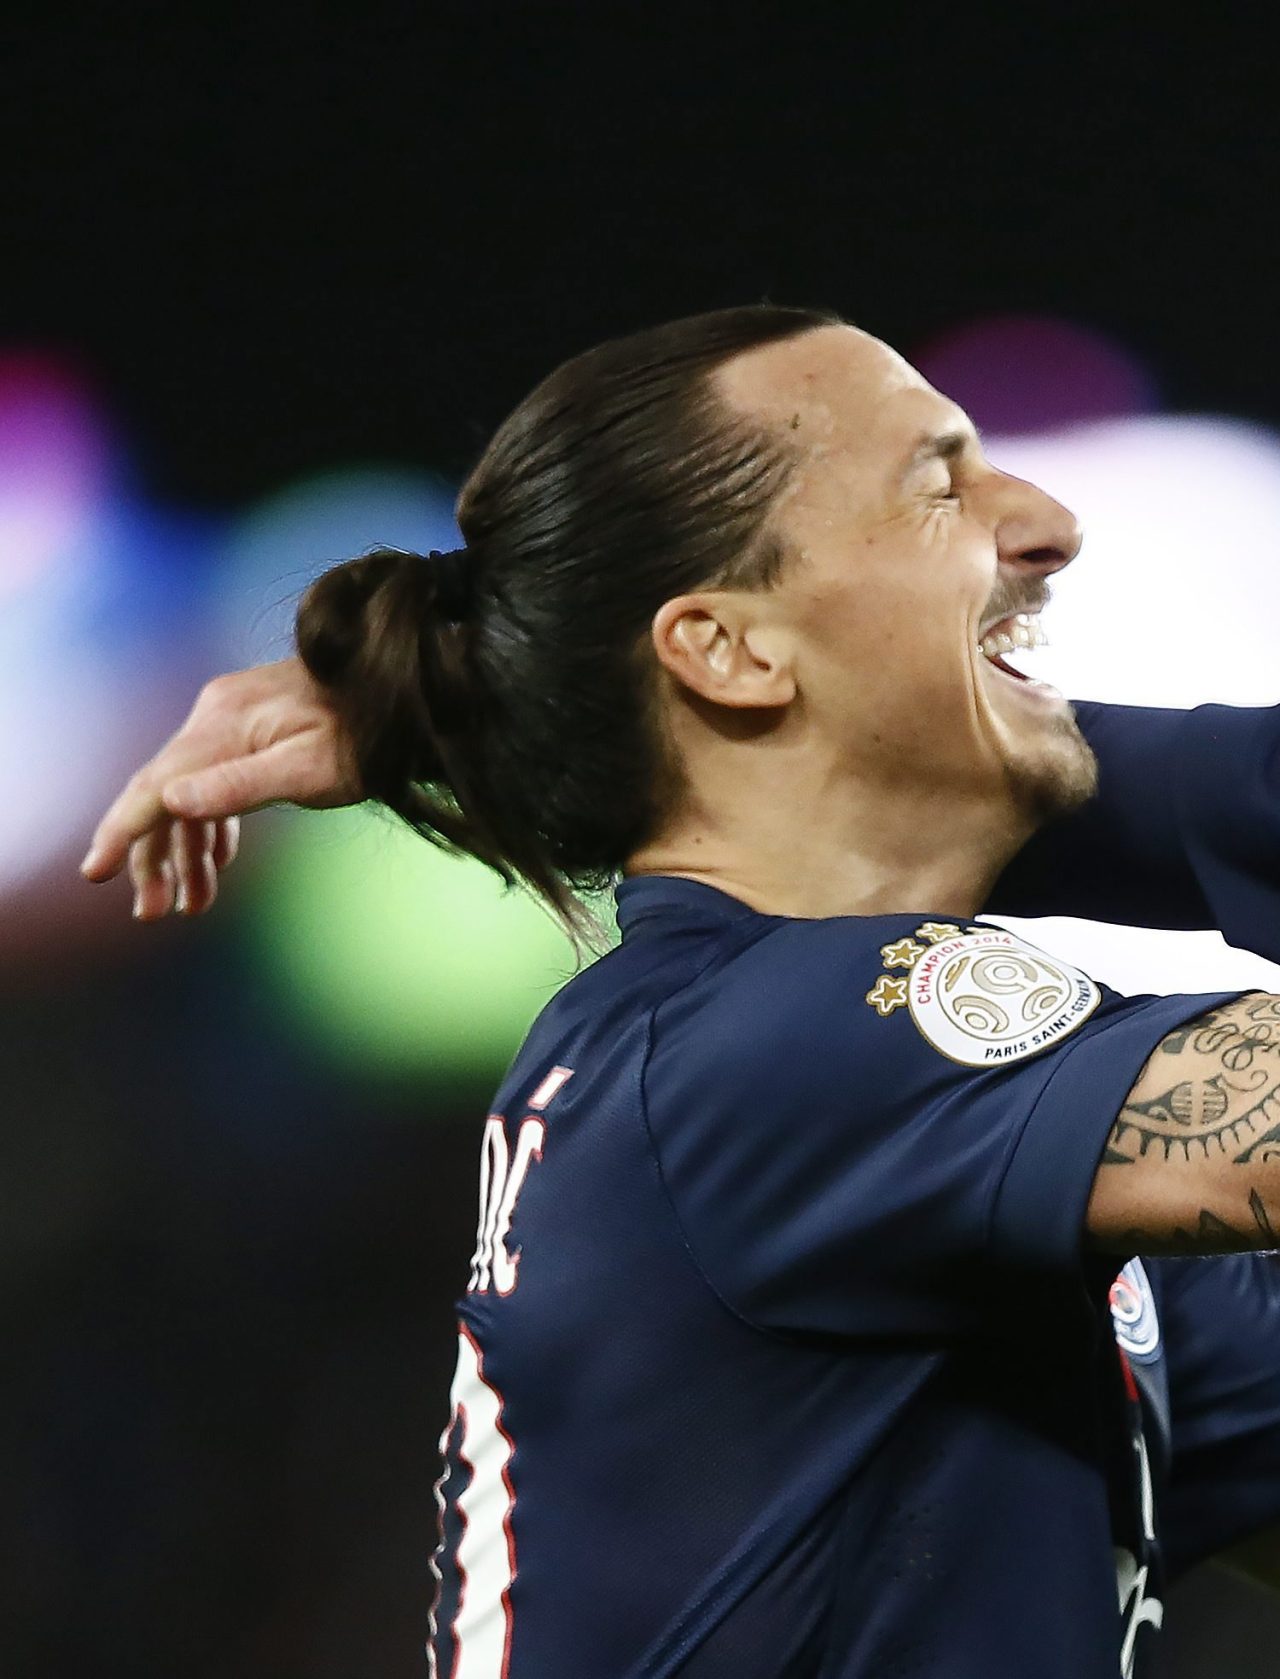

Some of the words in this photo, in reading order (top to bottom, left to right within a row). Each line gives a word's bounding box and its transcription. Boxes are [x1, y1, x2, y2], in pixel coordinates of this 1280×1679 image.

[917, 940, 965, 1004] CHAMPION
[973, 936, 1013, 945] 2014
[984, 1041, 1028, 1059] PARIS
